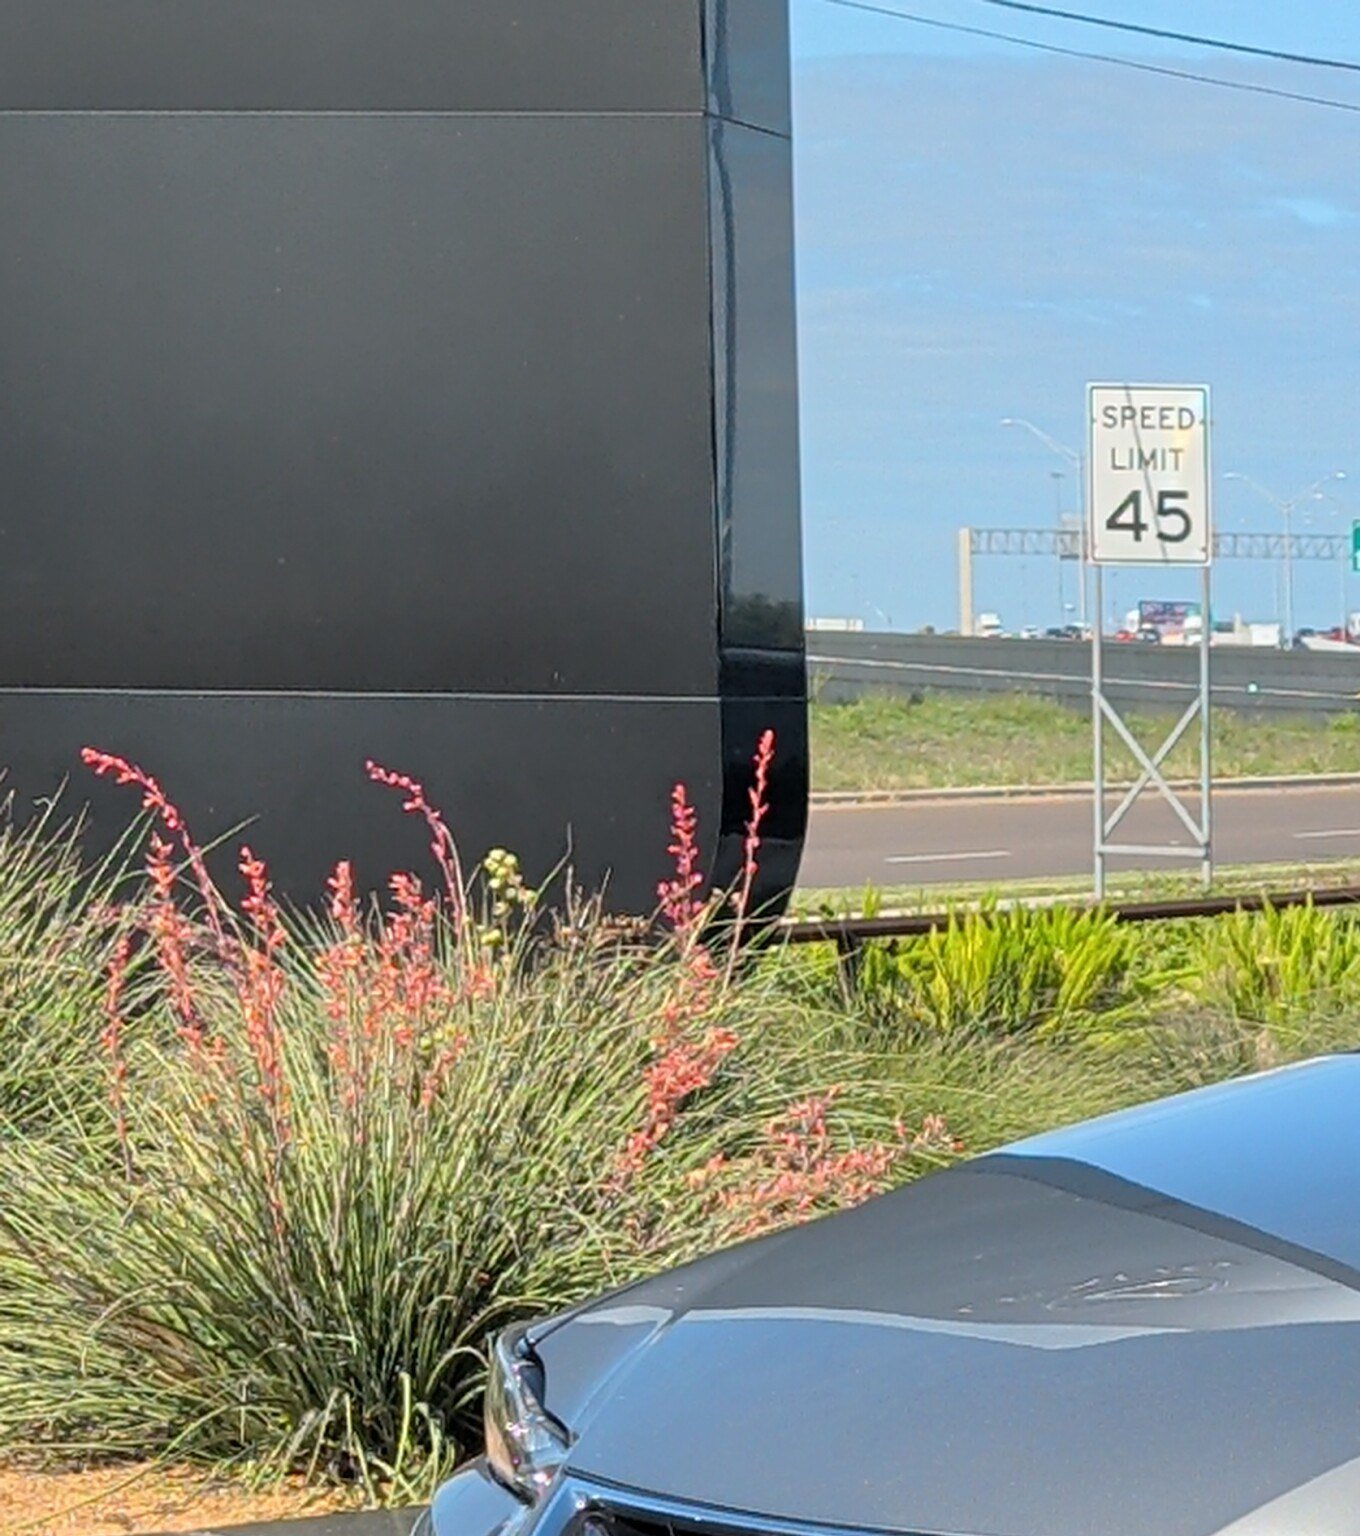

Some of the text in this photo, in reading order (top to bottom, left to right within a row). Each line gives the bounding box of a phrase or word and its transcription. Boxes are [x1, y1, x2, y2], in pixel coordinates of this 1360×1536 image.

[1101, 406, 1196, 431] SPEED
[1111, 447, 1185, 472] LIMIT
[1106, 489, 1193, 543] 45
